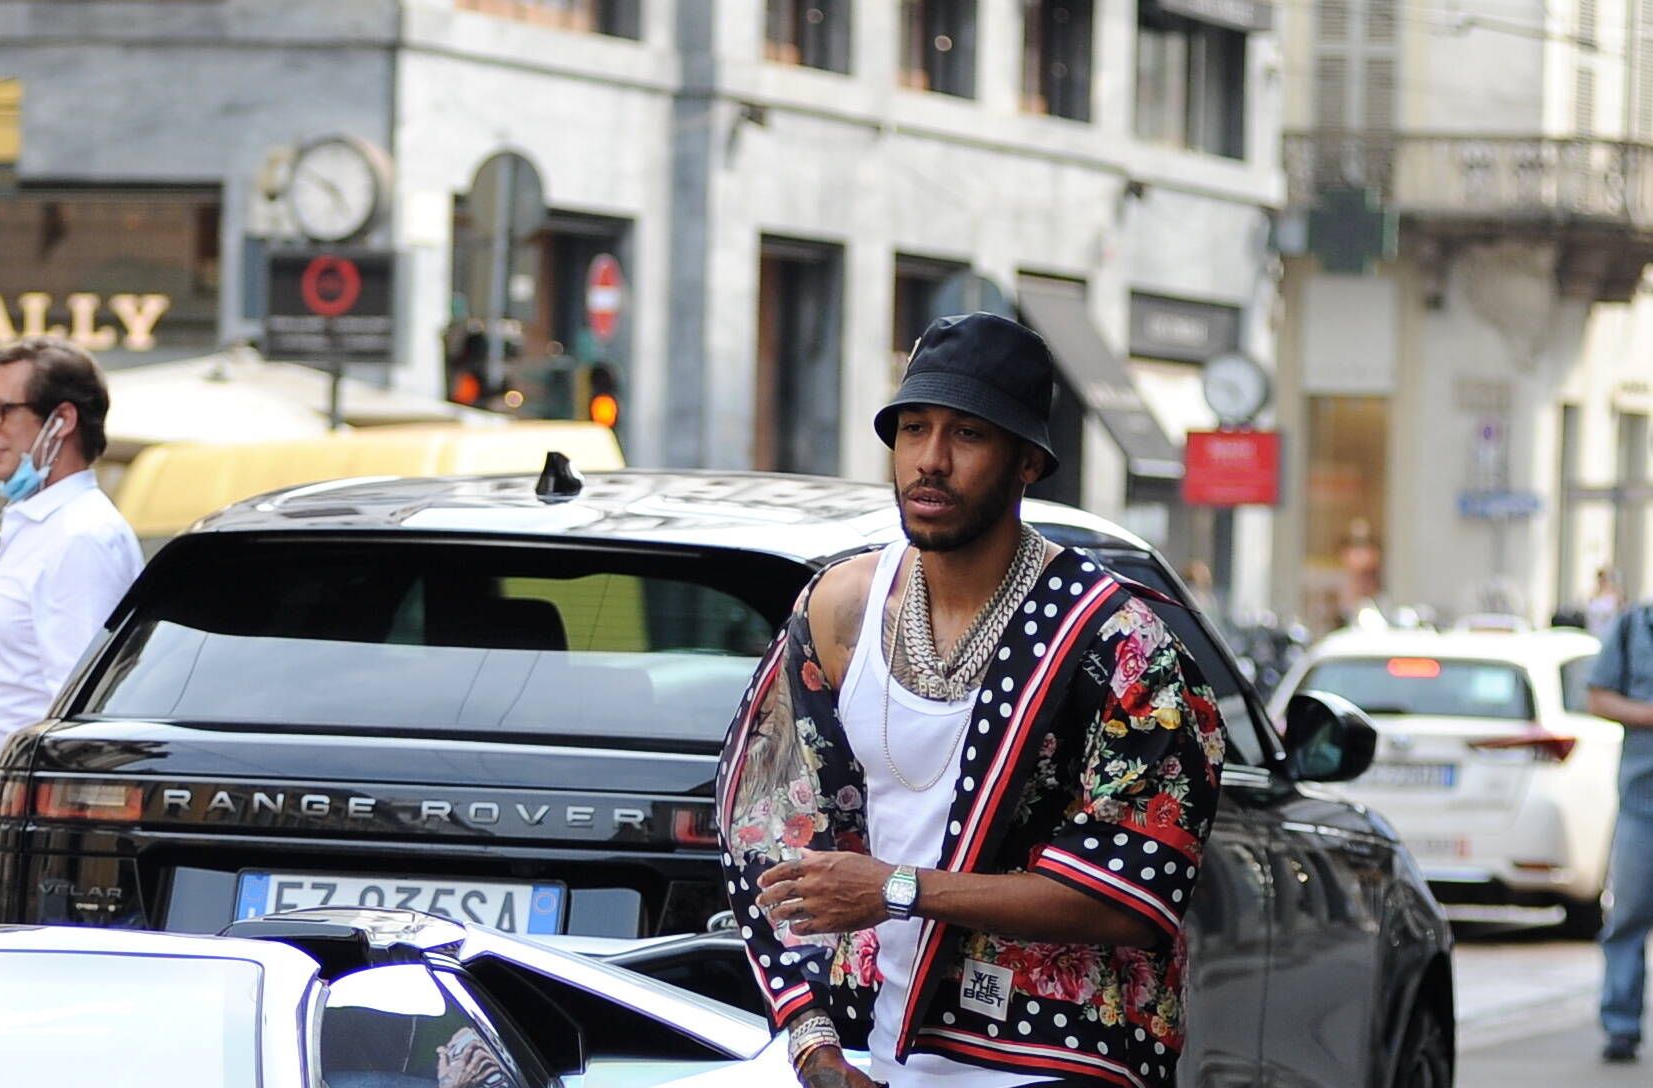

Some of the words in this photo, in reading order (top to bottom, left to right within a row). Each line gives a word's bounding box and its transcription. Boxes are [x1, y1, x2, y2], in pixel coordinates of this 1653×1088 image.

[163, 789, 376, 818] RANGE
[421, 800, 645, 829] ROVER
[973, 970, 1000, 986] WE
[969, 979, 1000, 997] THE
[963, 988, 1005, 1007] BEST
